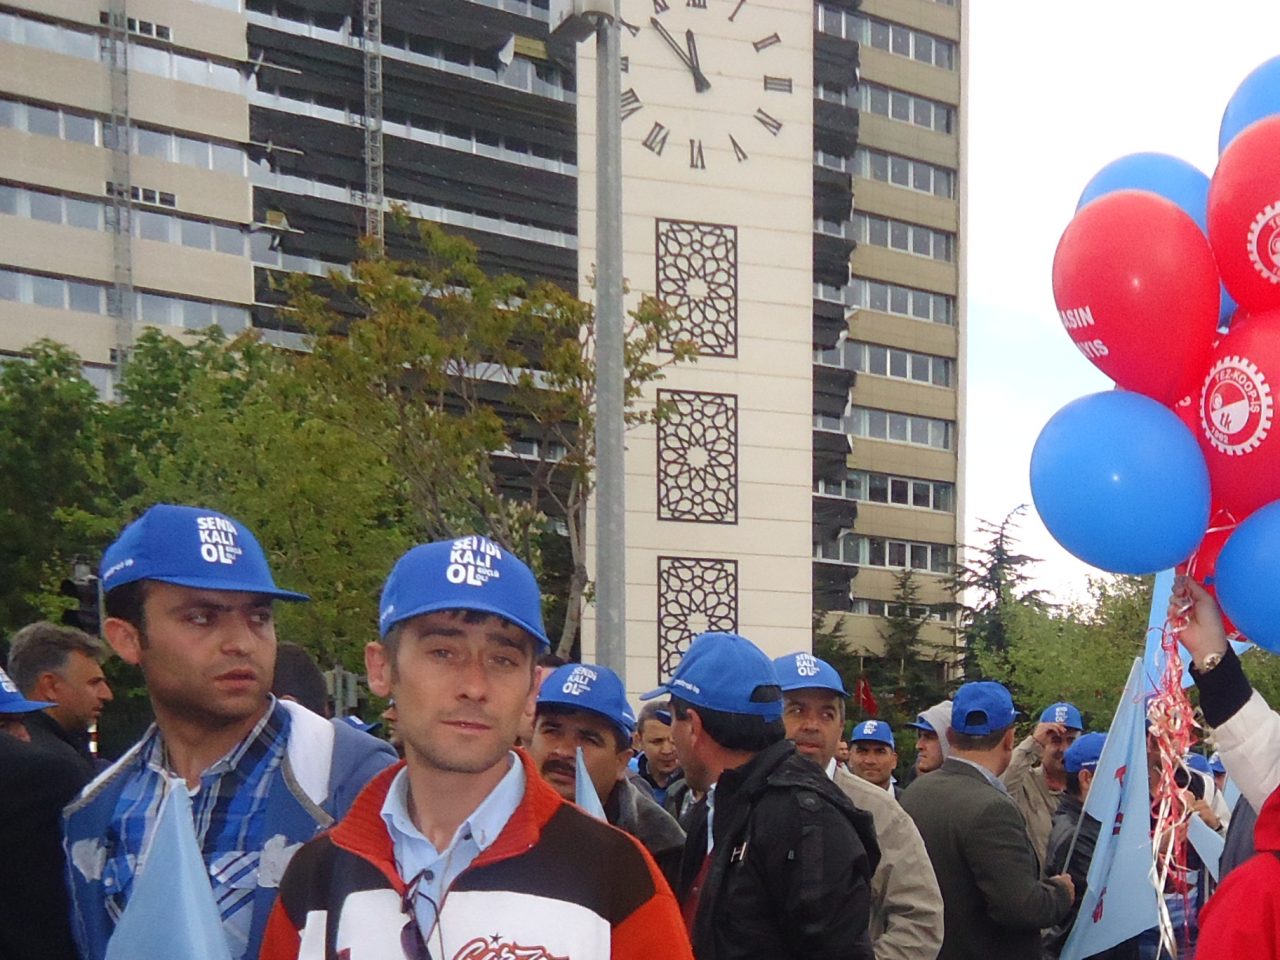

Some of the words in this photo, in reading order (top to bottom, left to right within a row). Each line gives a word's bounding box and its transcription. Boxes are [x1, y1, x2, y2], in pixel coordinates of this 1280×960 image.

[763, 75, 792, 94] III
[199, 530, 234, 546] KALI
[200, 545, 233, 565] OL
[450, 550, 491, 567] KALI
[446, 564, 482, 587] OL
